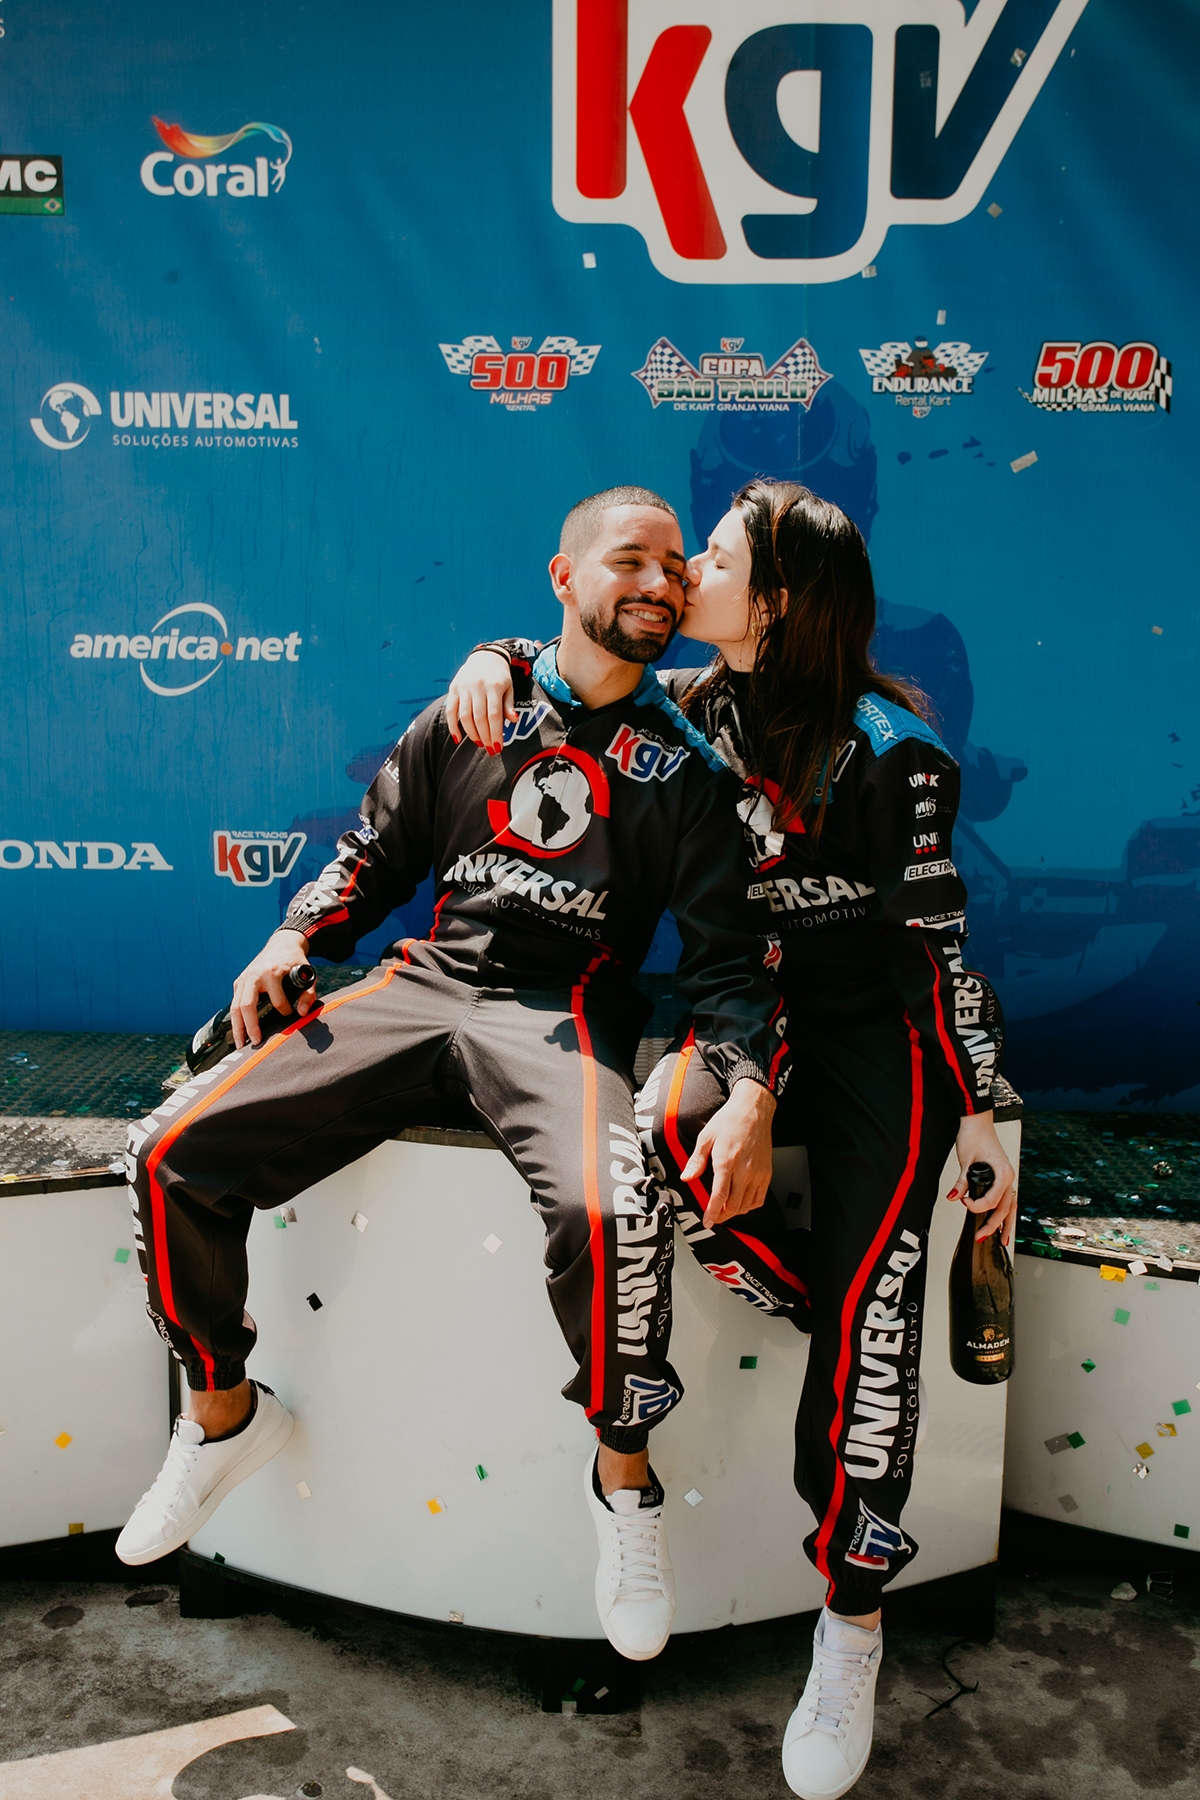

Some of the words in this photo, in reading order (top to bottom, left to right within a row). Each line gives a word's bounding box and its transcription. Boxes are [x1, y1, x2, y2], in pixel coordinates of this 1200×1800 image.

[140, 151, 269, 197] Coral
[470, 353, 570, 390] 500
[702, 357, 764, 377] COPA
[1033, 341, 1159, 391] 500
[716, 378, 810, 402] PAULO
[872, 376, 974, 393] ENDURANCE
[489, 391, 553, 405] MILHAS
[895, 394, 927, 406] Rental
[929, 394, 952, 406] Kart
[1032, 387, 1109, 403] MILHAS
[1110, 390, 1122, 399] DE
[1123, 390, 1156, 402] KART
[110, 391, 298, 430] UNIVERSAL
[505, 404, 537, 412] RENTAL
[673, 403, 687, 411] DE
[689, 403, 716, 411] KART
[717, 403, 757, 412] GRANJA
[759, 403, 790, 412] VIANA
[1080, 402, 1122, 412] GRANJA
[1123, 403, 1156, 412] VIANA
[113, 433, 189, 449] SOLUÇÕES
[195, 435, 299, 449] AUTOMOTIVAS
[856, 697, 898, 742] ORTEX
[231, 830, 254, 839] RACE
[255, 831, 289, 839] TRACKS
